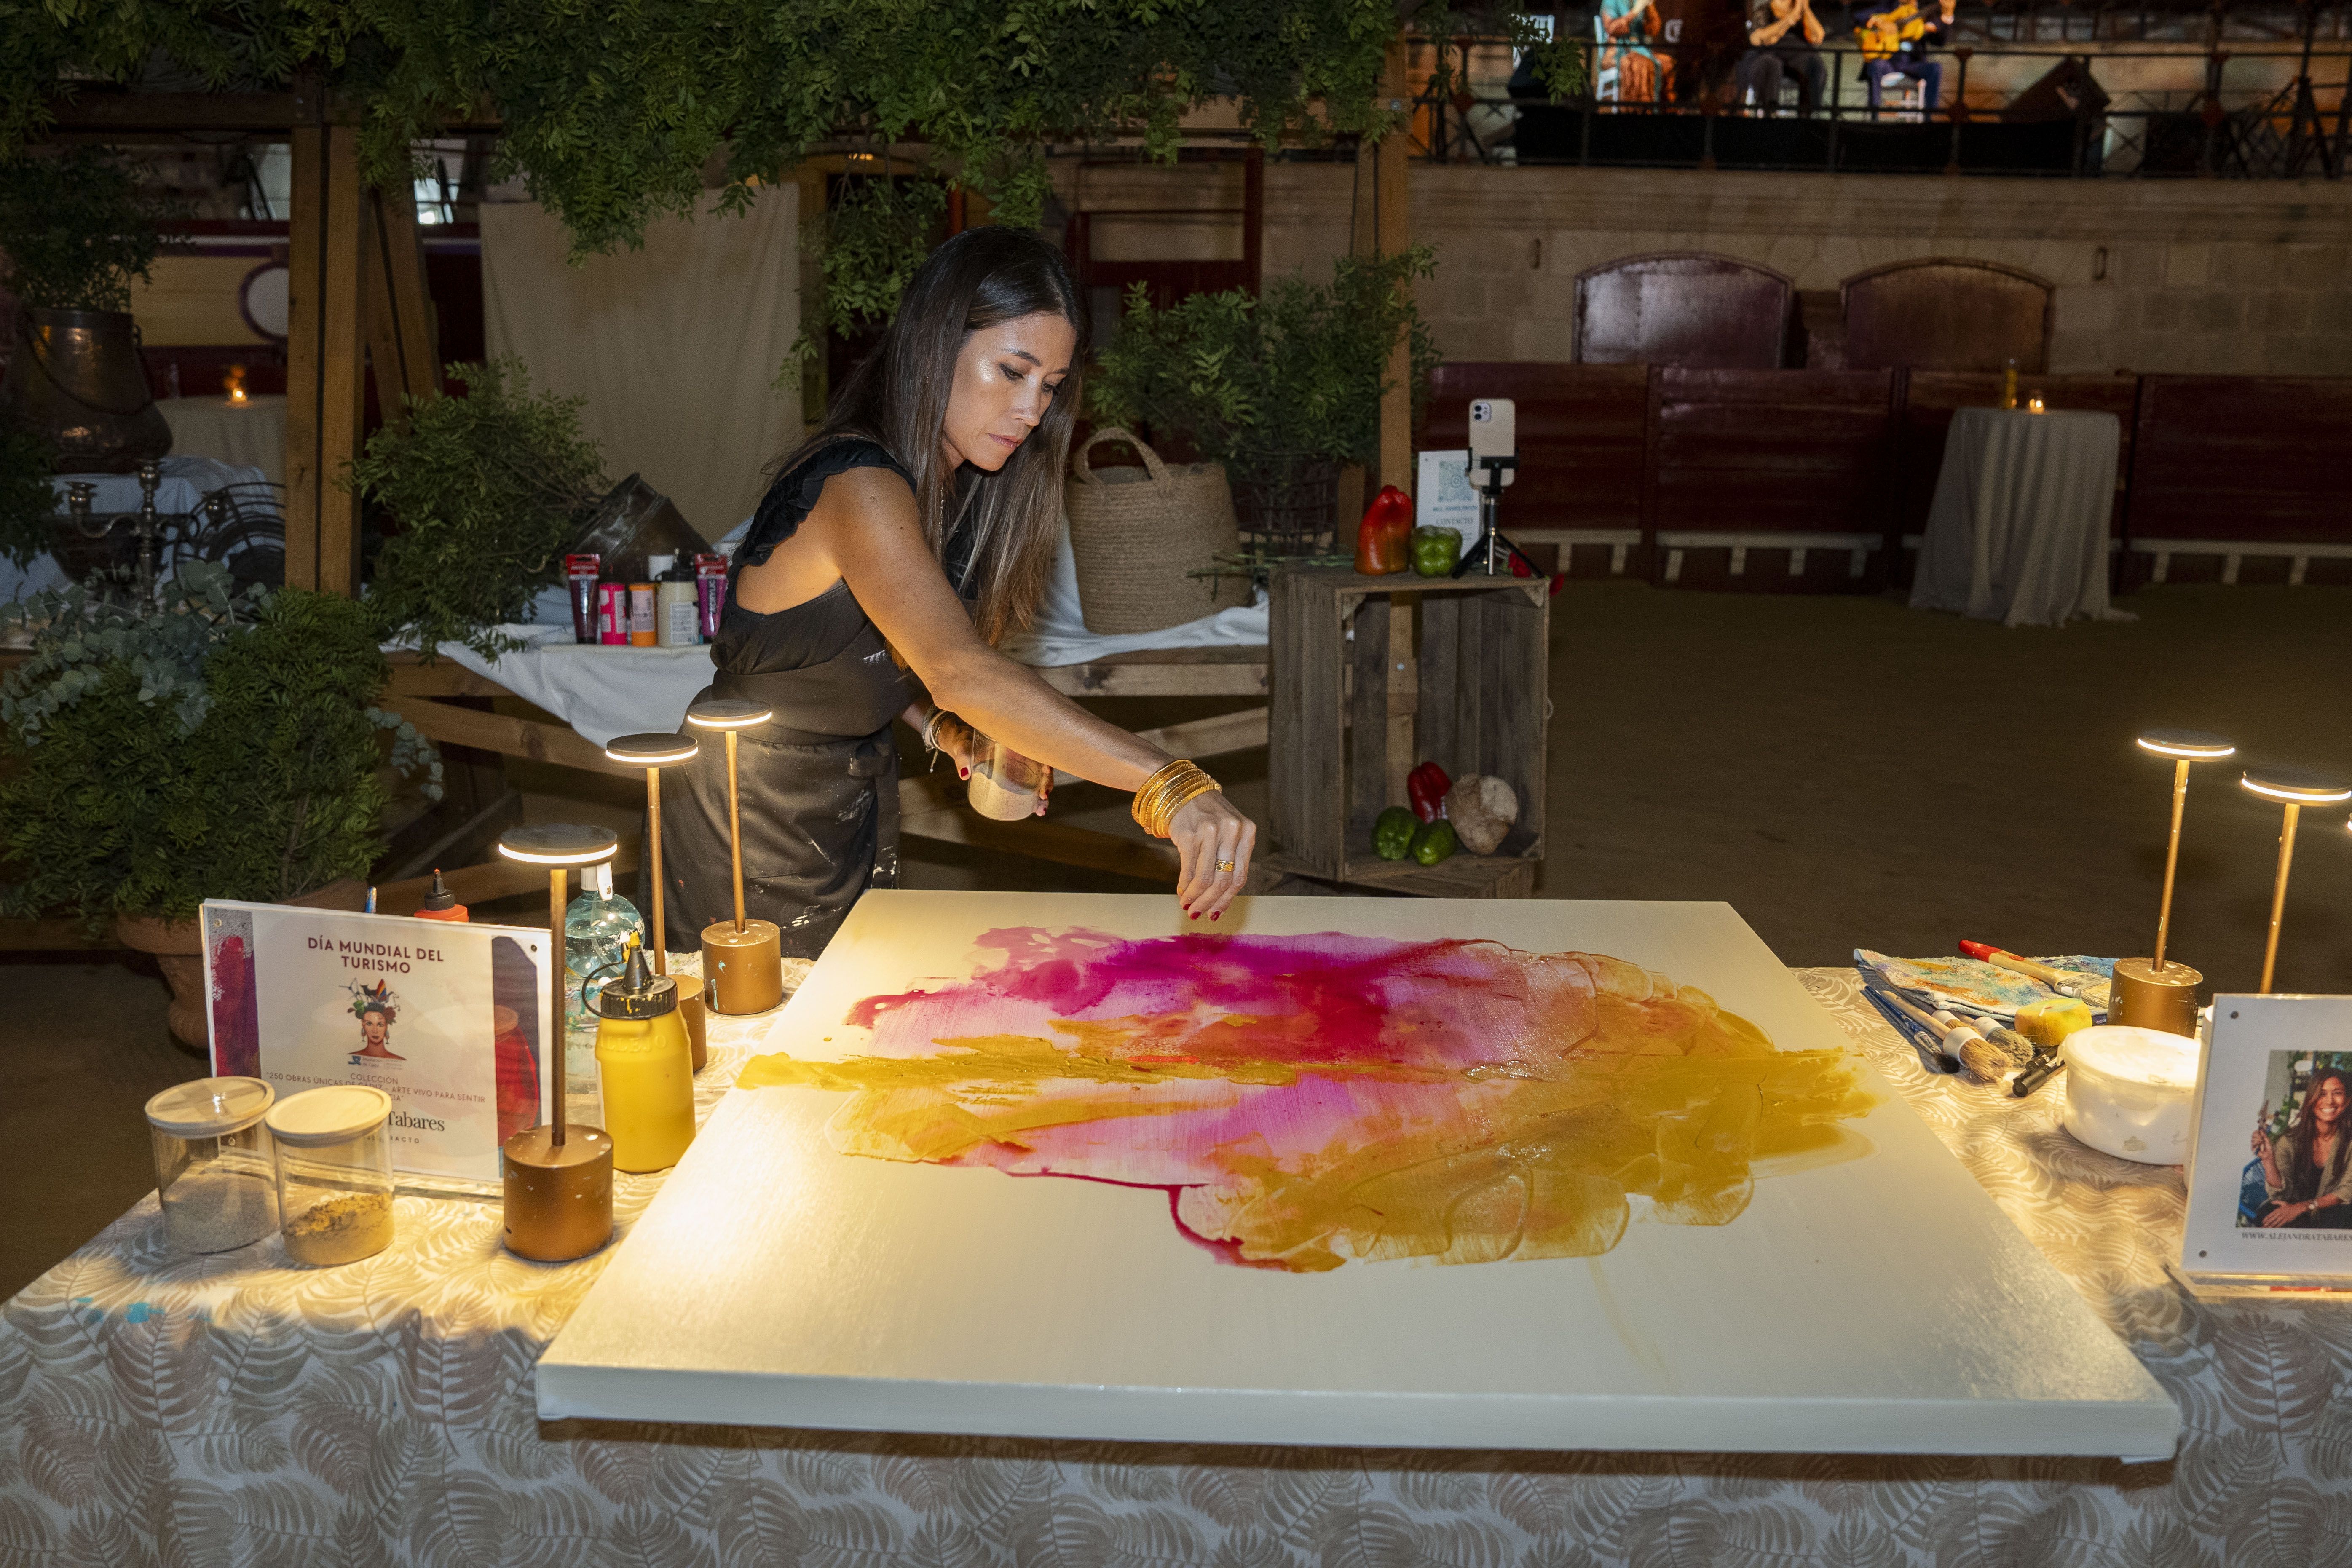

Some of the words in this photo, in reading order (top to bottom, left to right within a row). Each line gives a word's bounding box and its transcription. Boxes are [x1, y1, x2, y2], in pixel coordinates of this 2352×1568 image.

[308, 935, 334, 951] DÍA
[339, 940, 411, 958] MUNDIAL
[416, 948, 444, 962] DEL
[341, 955, 411, 973] TURISMO
[285, 1074, 312, 1083] OBRAS
[313, 1076, 343, 1086] ÚNICAS
[392, 1086, 411, 1094] ARTE
[414, 1089, 433, 1097] VIVO
[435, 1092, 455, 1100] PARA
[458, 1094, 485, 1102] SENTIR
[351, 1073, 398, 1084] COLECCIÓN
[388, 1111, 445, 1131] Tabares
